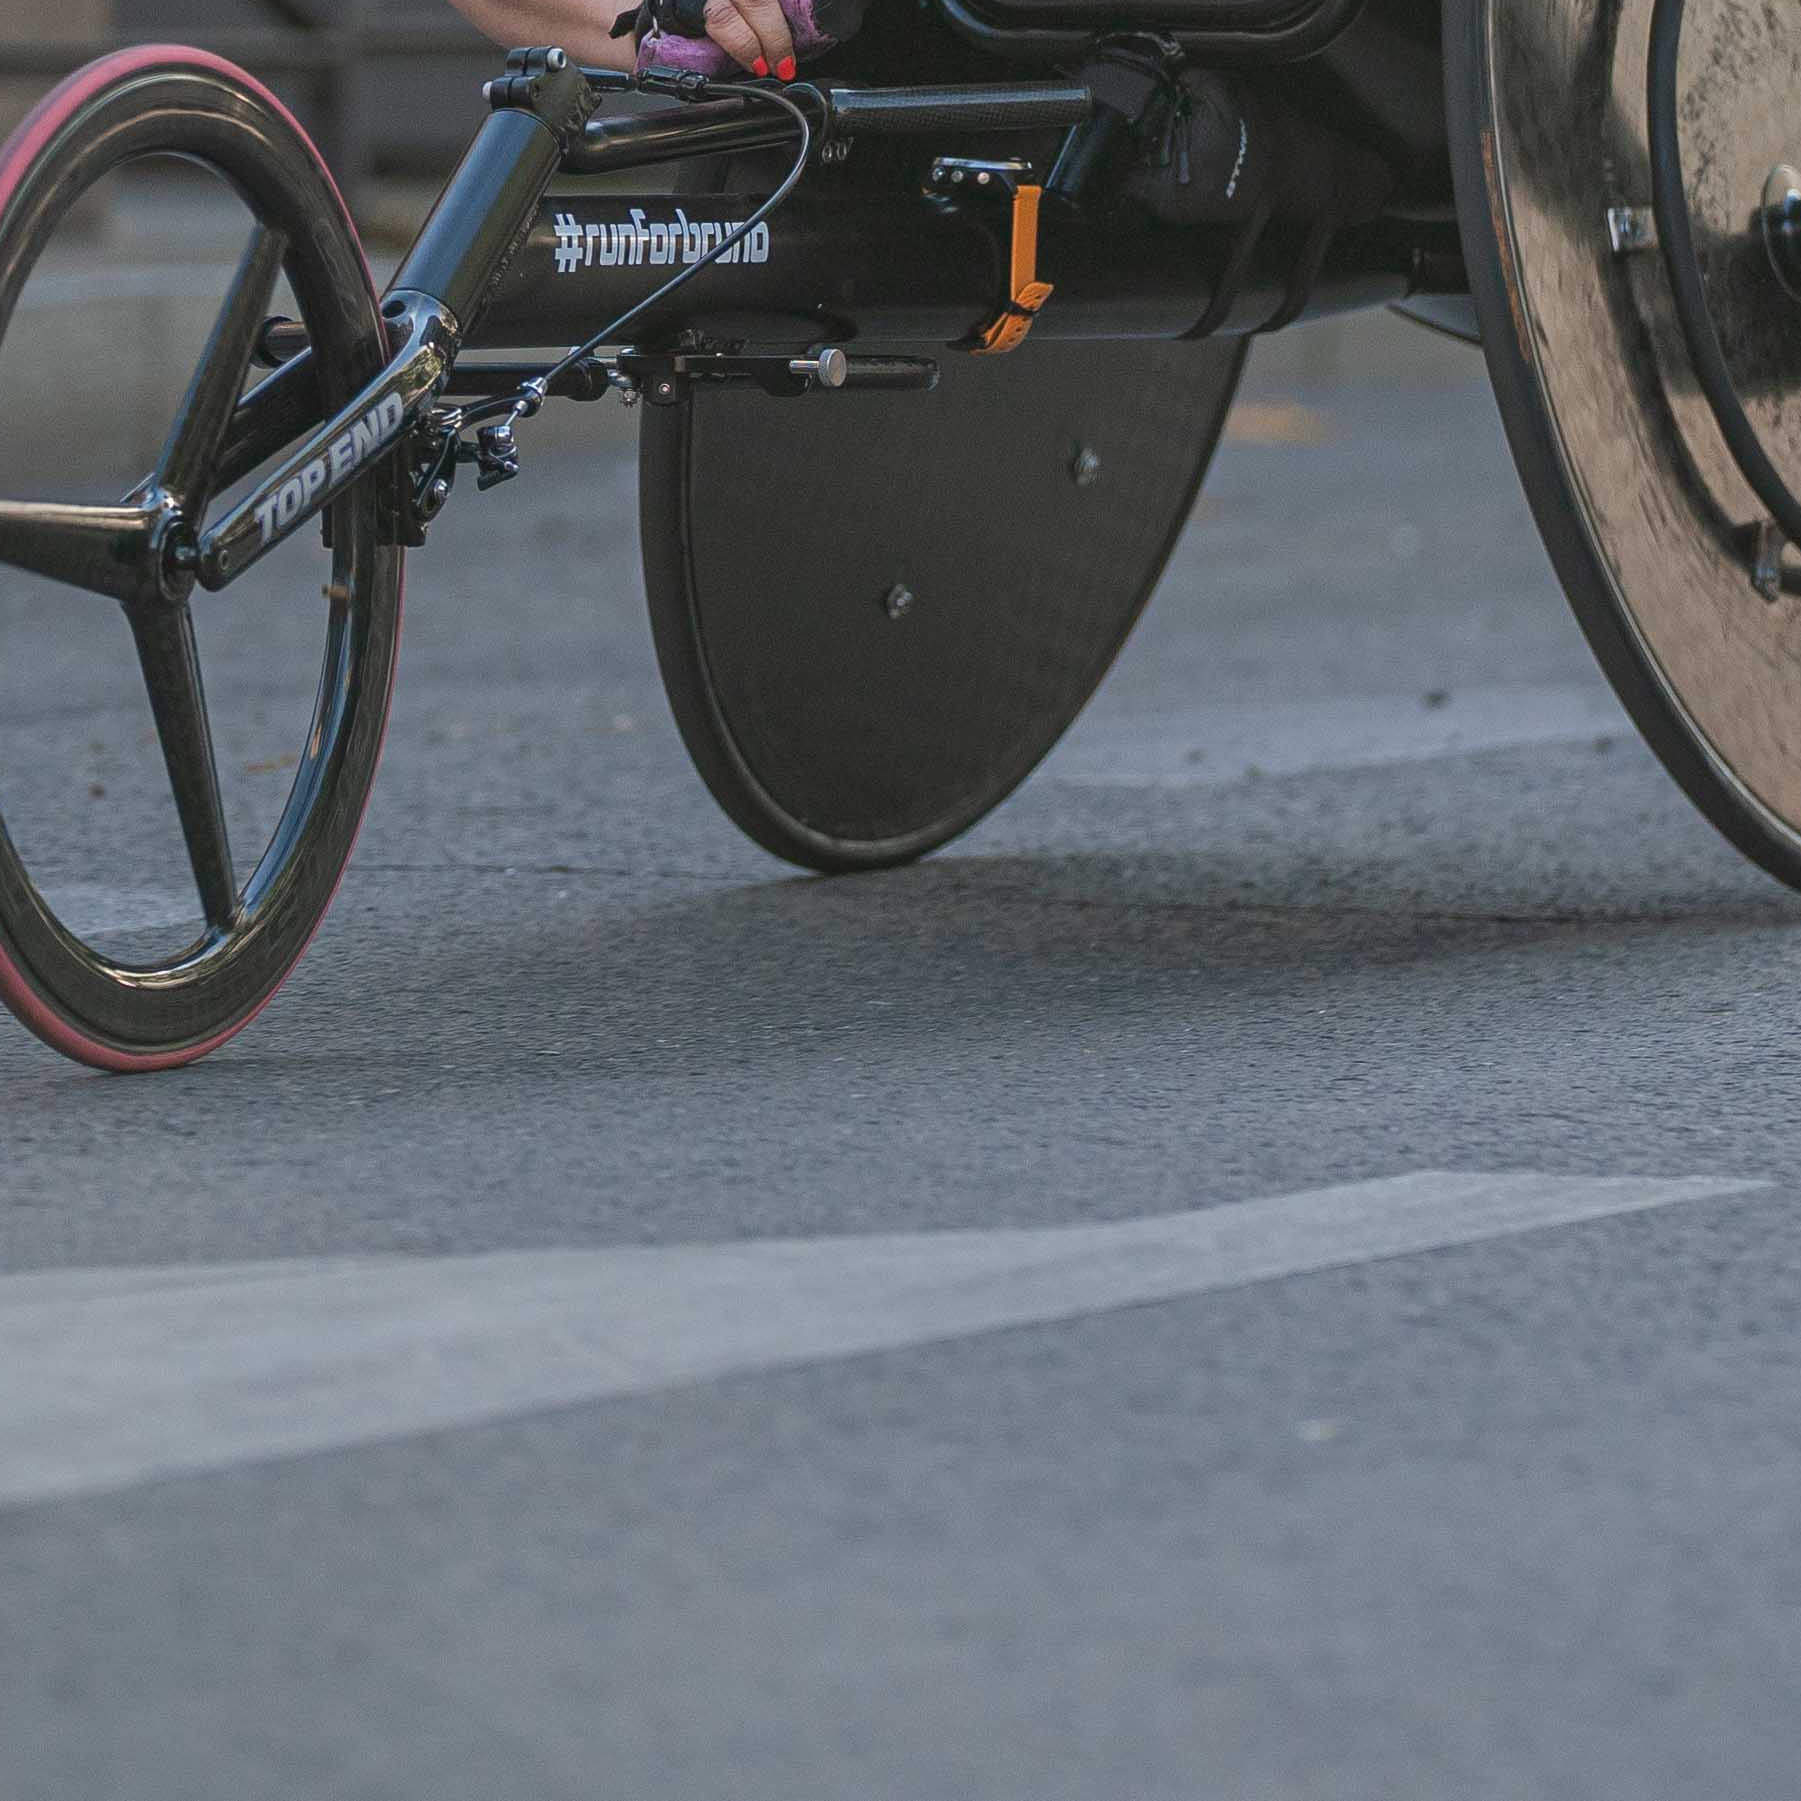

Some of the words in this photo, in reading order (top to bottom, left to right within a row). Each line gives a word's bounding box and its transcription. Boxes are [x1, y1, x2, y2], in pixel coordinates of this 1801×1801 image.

[553, 208, 770, 273] #runforbruno
[253, 457, 327, 548] TOP
[327, 391, 405, 487] END
